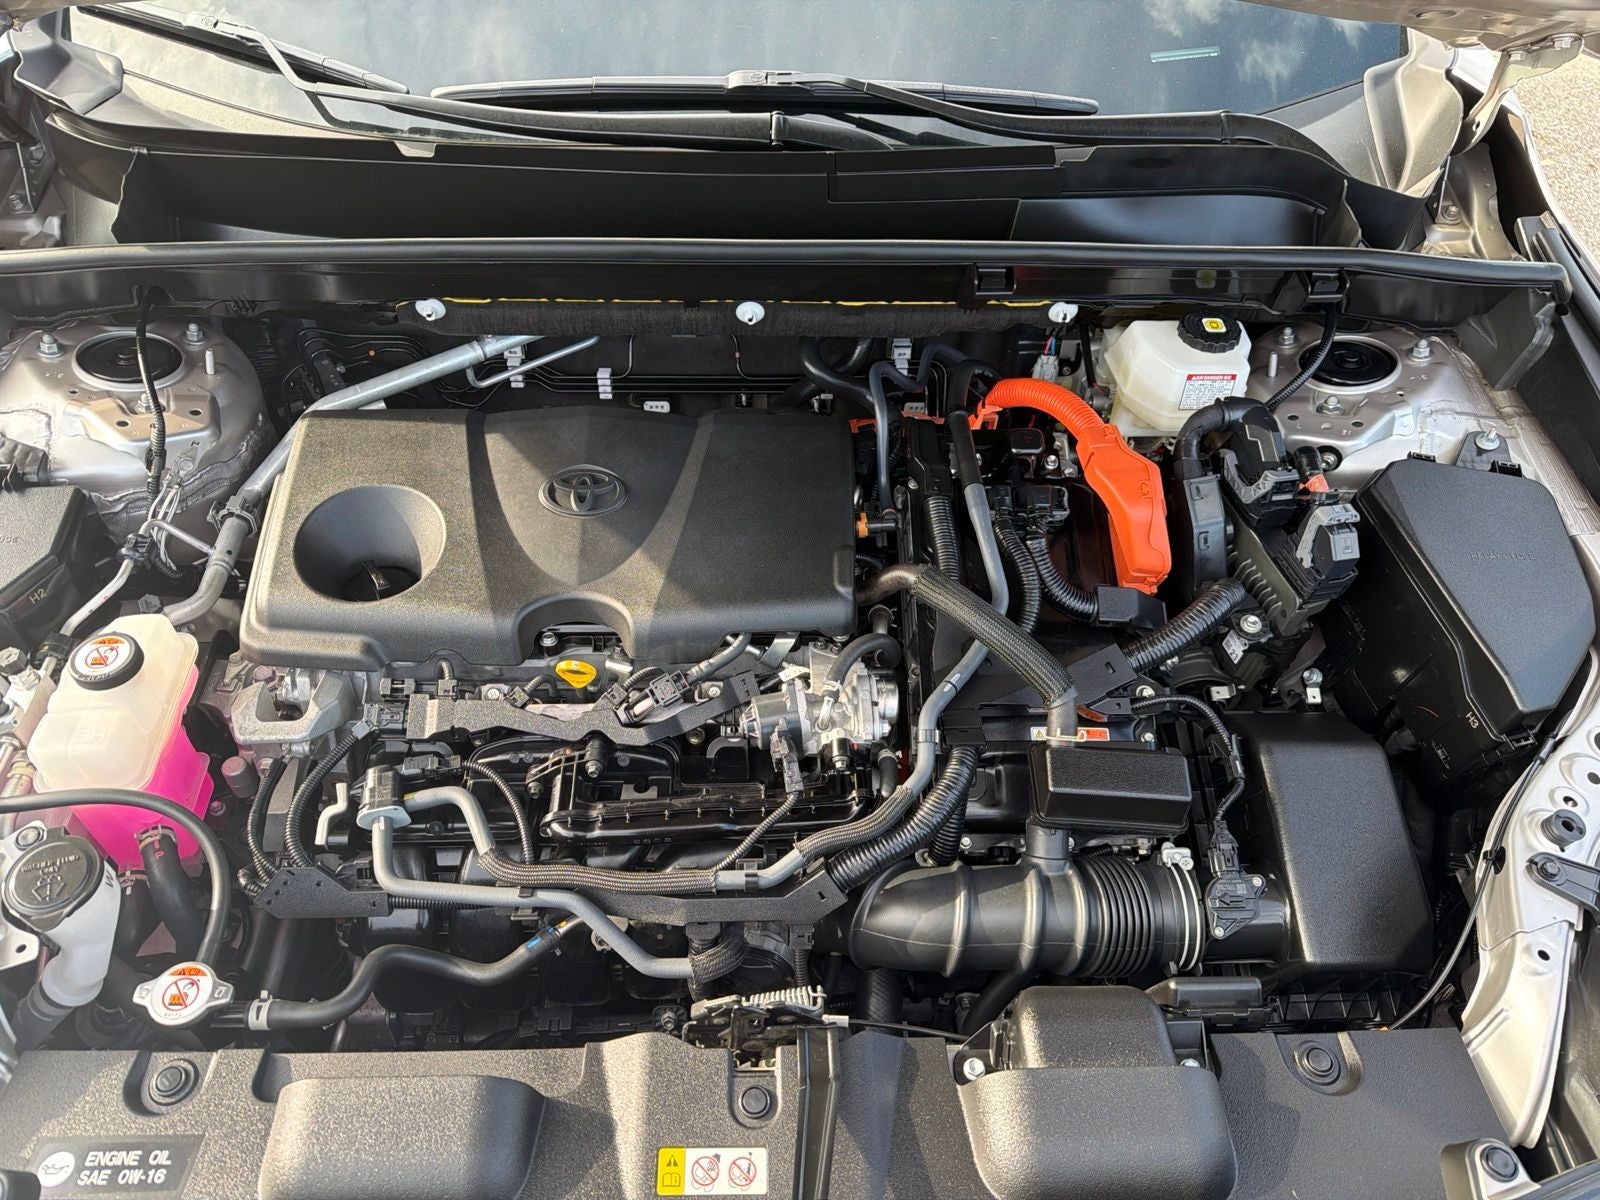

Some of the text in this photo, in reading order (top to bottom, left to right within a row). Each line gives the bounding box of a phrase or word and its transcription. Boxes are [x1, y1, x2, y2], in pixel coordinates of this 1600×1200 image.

[29, 587, 47, 605] H2
[1465, 711, 1479, 729] H3
[84, 1149, 172, 1167] ENGINE OIL
[77, 1168, 167, 1187] SAE 0W-16
